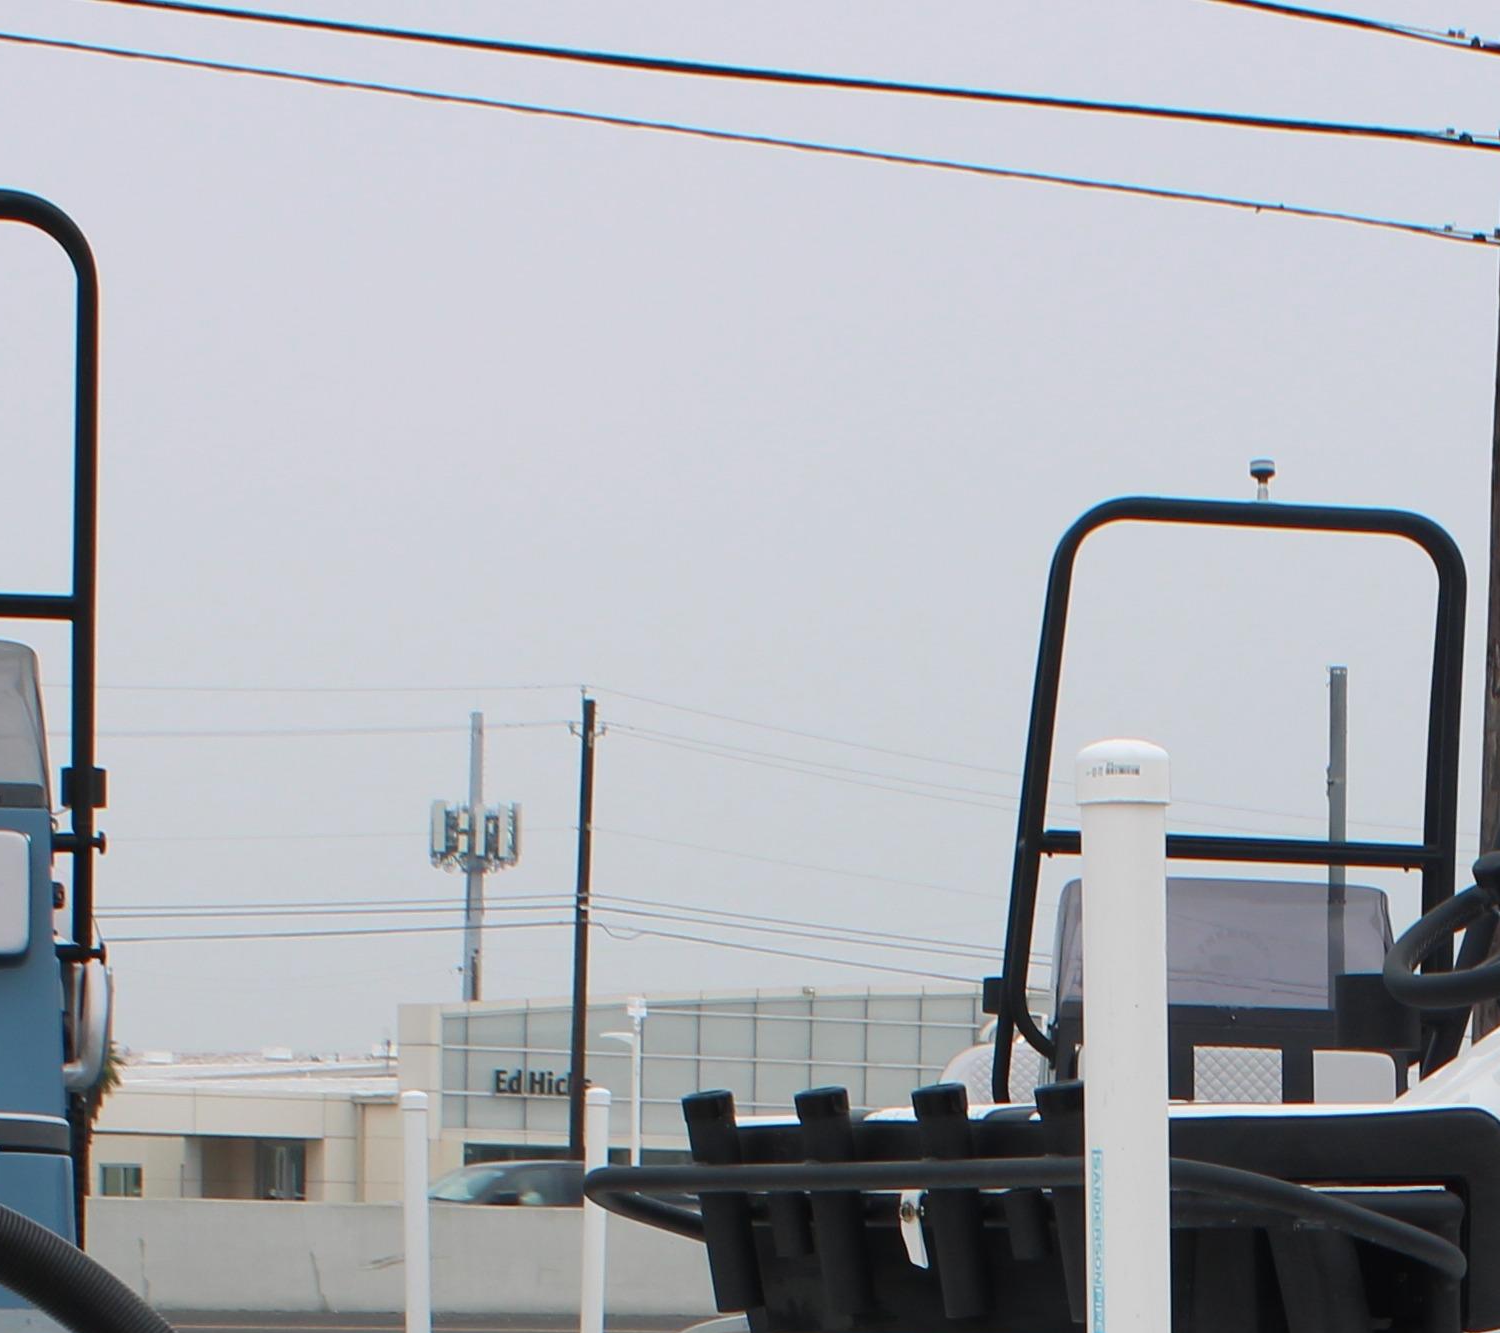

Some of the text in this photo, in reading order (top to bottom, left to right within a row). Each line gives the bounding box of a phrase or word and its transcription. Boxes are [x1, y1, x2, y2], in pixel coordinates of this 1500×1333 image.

[495, 1069, 522, 1094] Ed
[1092, 1155, 1104, 1333] SANDERSON PIPE
